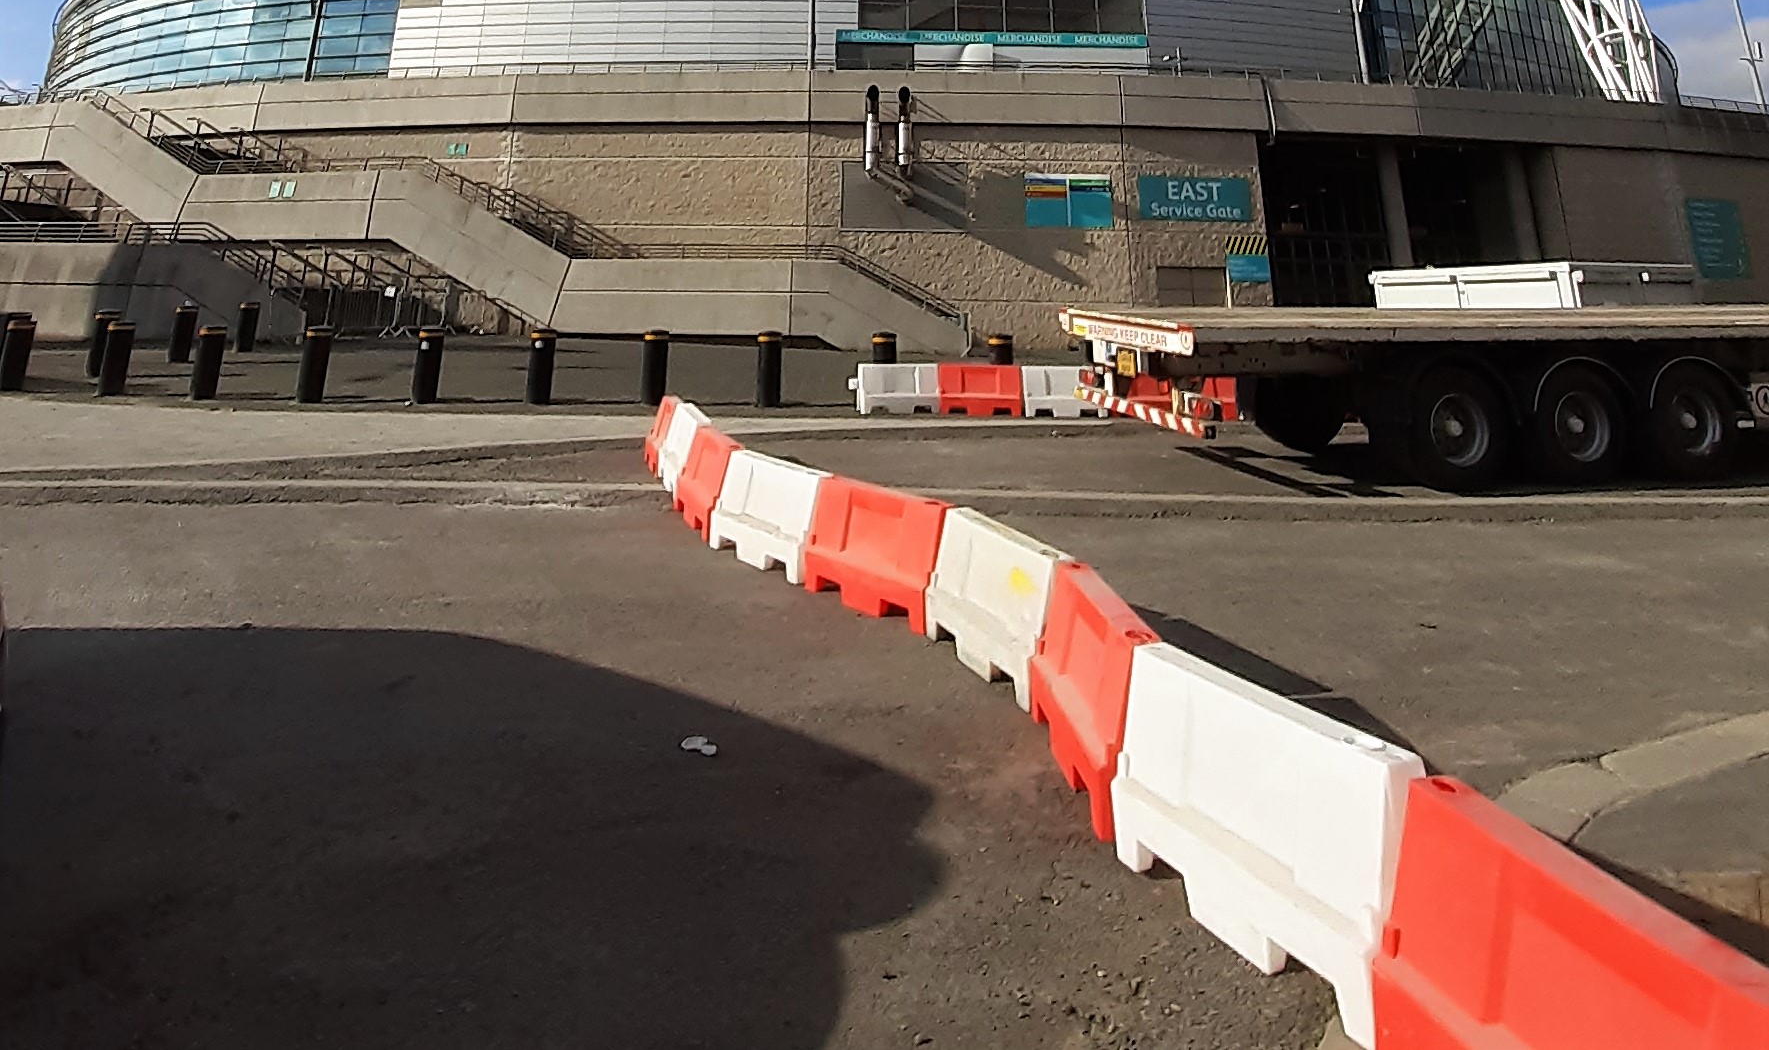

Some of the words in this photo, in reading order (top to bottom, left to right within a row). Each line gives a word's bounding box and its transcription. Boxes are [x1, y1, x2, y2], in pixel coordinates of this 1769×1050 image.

[920, 32, 985, 42] MERCHANDISE
[997, 33, 1061, 44] MERCHANDISE
[1074, 34, 1138, 45] MERCHANDISE
[1167, 180, 1222, 201] EAST
[1149, 201, 1203, 218] Service
[1207, 206, 1242, 219] Gate
[1119, 329, 1138, 342] KEEP
[1140, 331, 1168, 347] CLEAR
